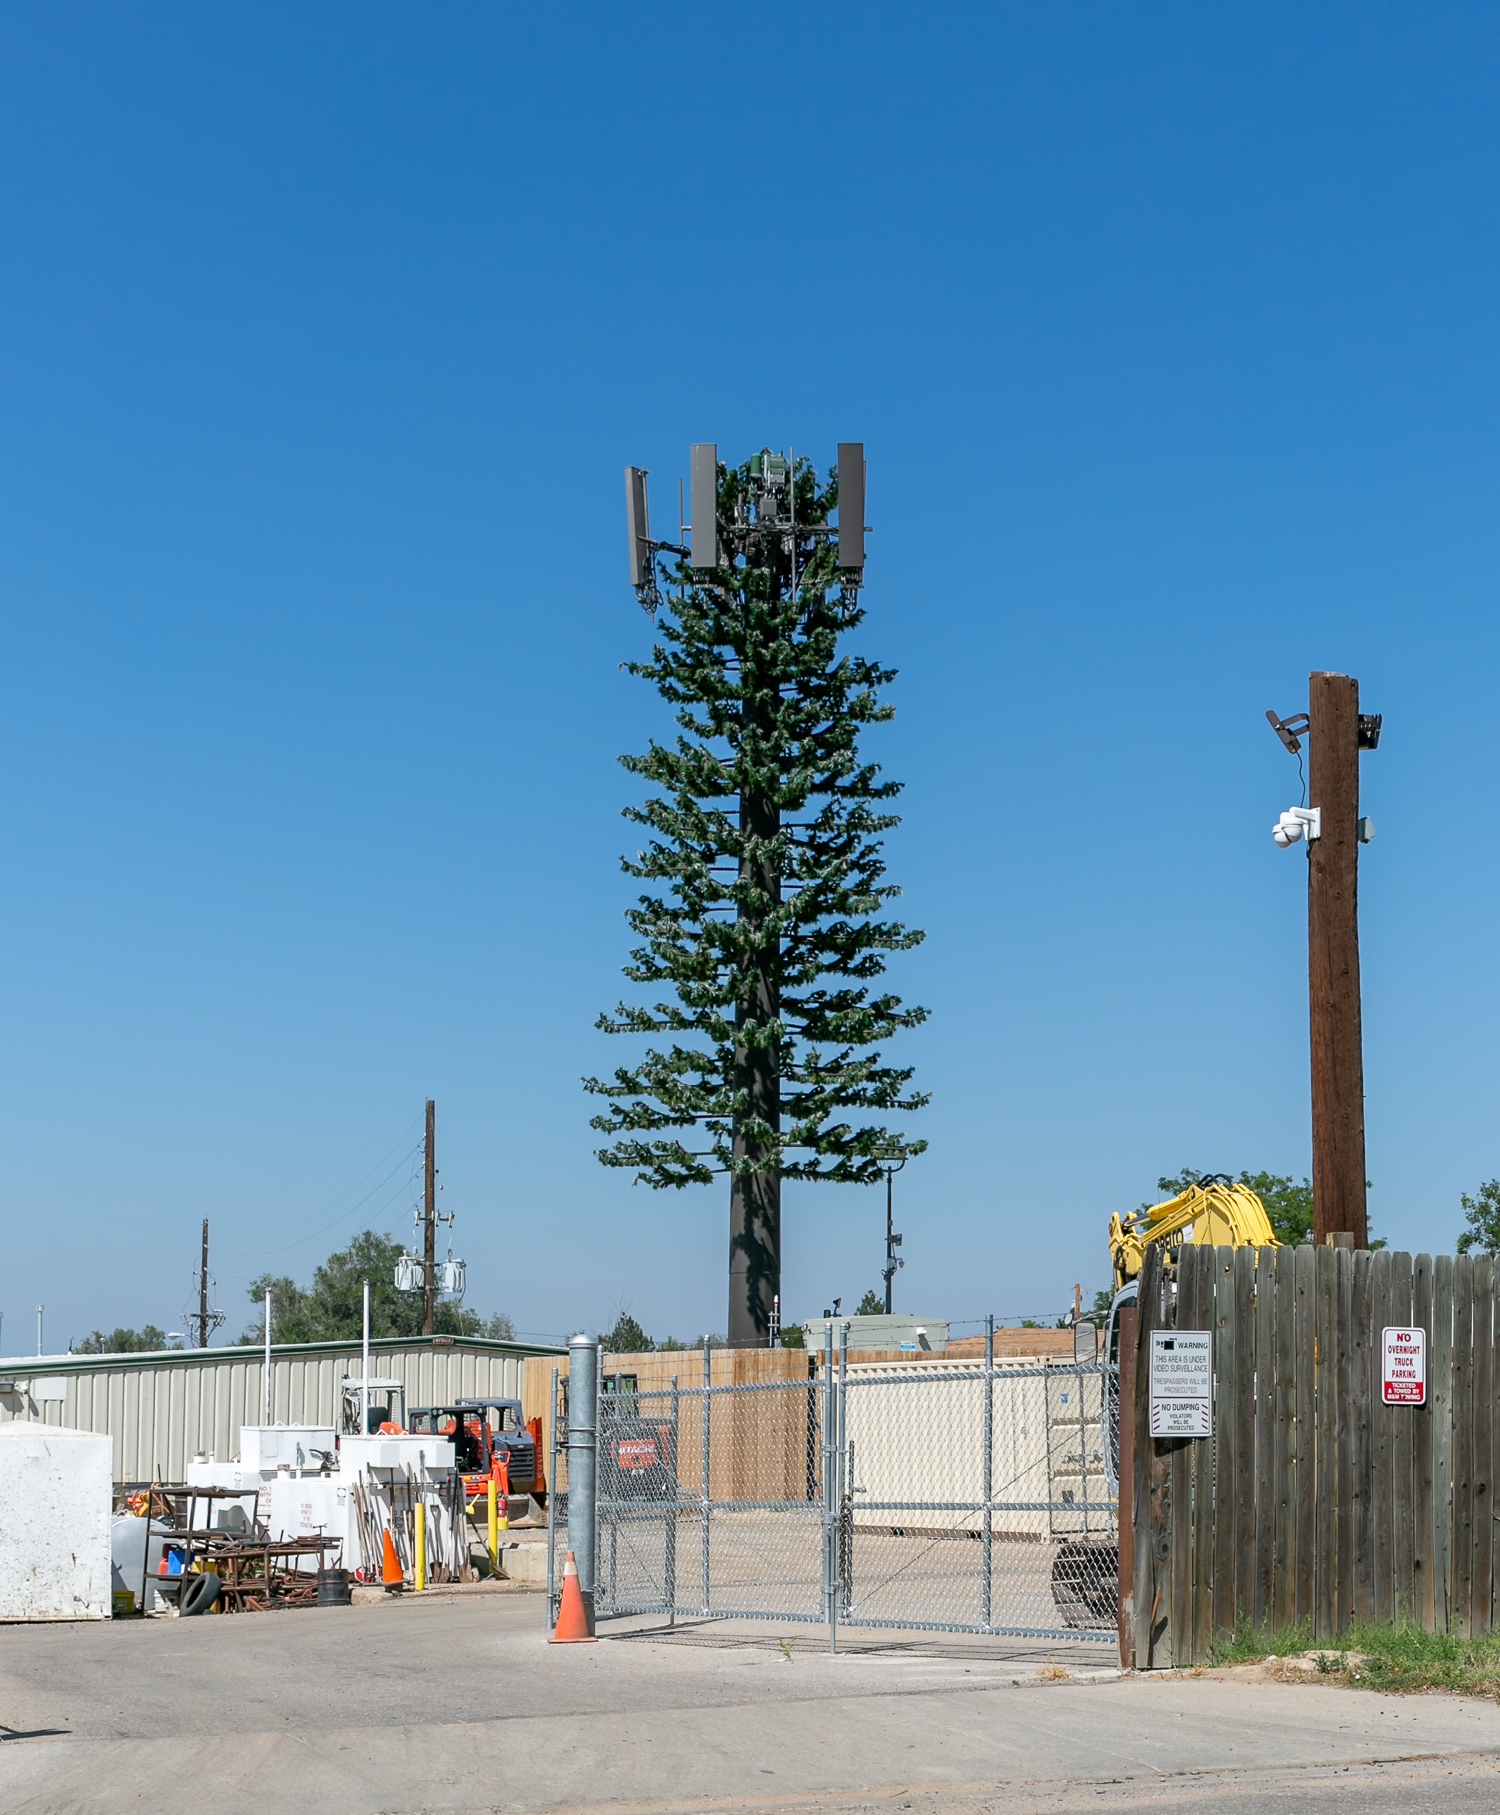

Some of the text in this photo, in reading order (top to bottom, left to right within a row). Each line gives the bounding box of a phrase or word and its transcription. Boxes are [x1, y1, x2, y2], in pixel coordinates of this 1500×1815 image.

[1396, 1333, 1412, 1342] NO
[1388, 1345, 1420, 1354] OVERNIGHT
[1155, 1355, 1206, 1363] THIS AREA IS UNDER
[1394, 1358, 1414, 1366] TRUCK
[1392, 1370, 1416, 1378] PARKING
